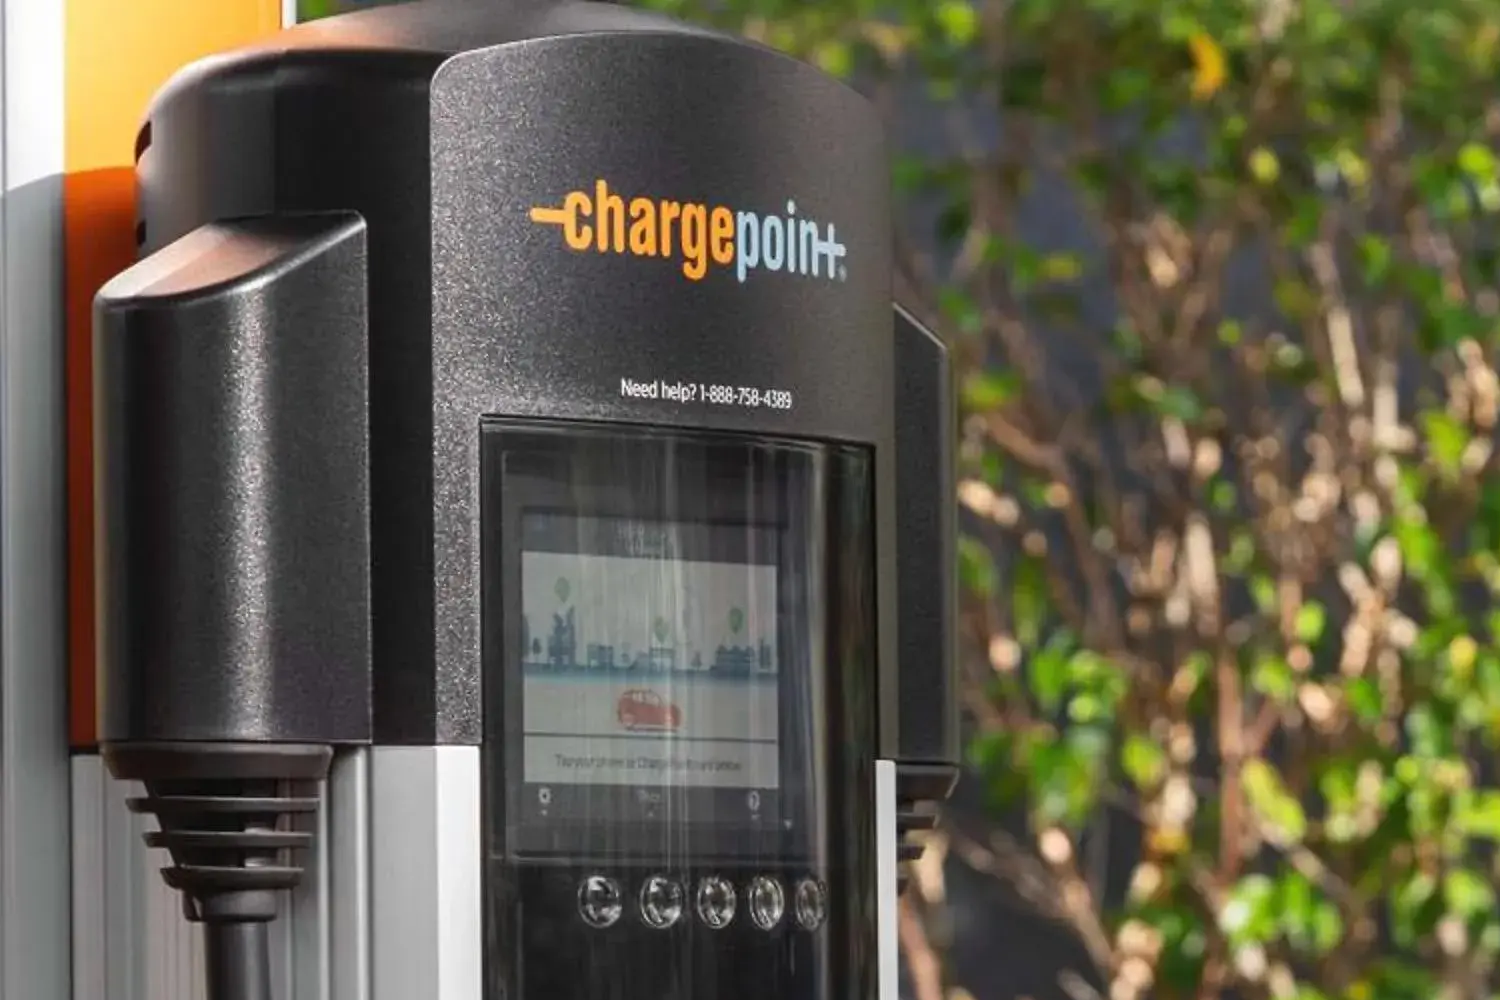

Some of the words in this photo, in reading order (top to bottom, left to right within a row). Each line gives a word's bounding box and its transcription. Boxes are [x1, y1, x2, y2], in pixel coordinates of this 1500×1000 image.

[621, 377, 657, 399] Need
[661, 380, 697, 403] help?
[700, 384, 793, 409] 1-888-758-4389
